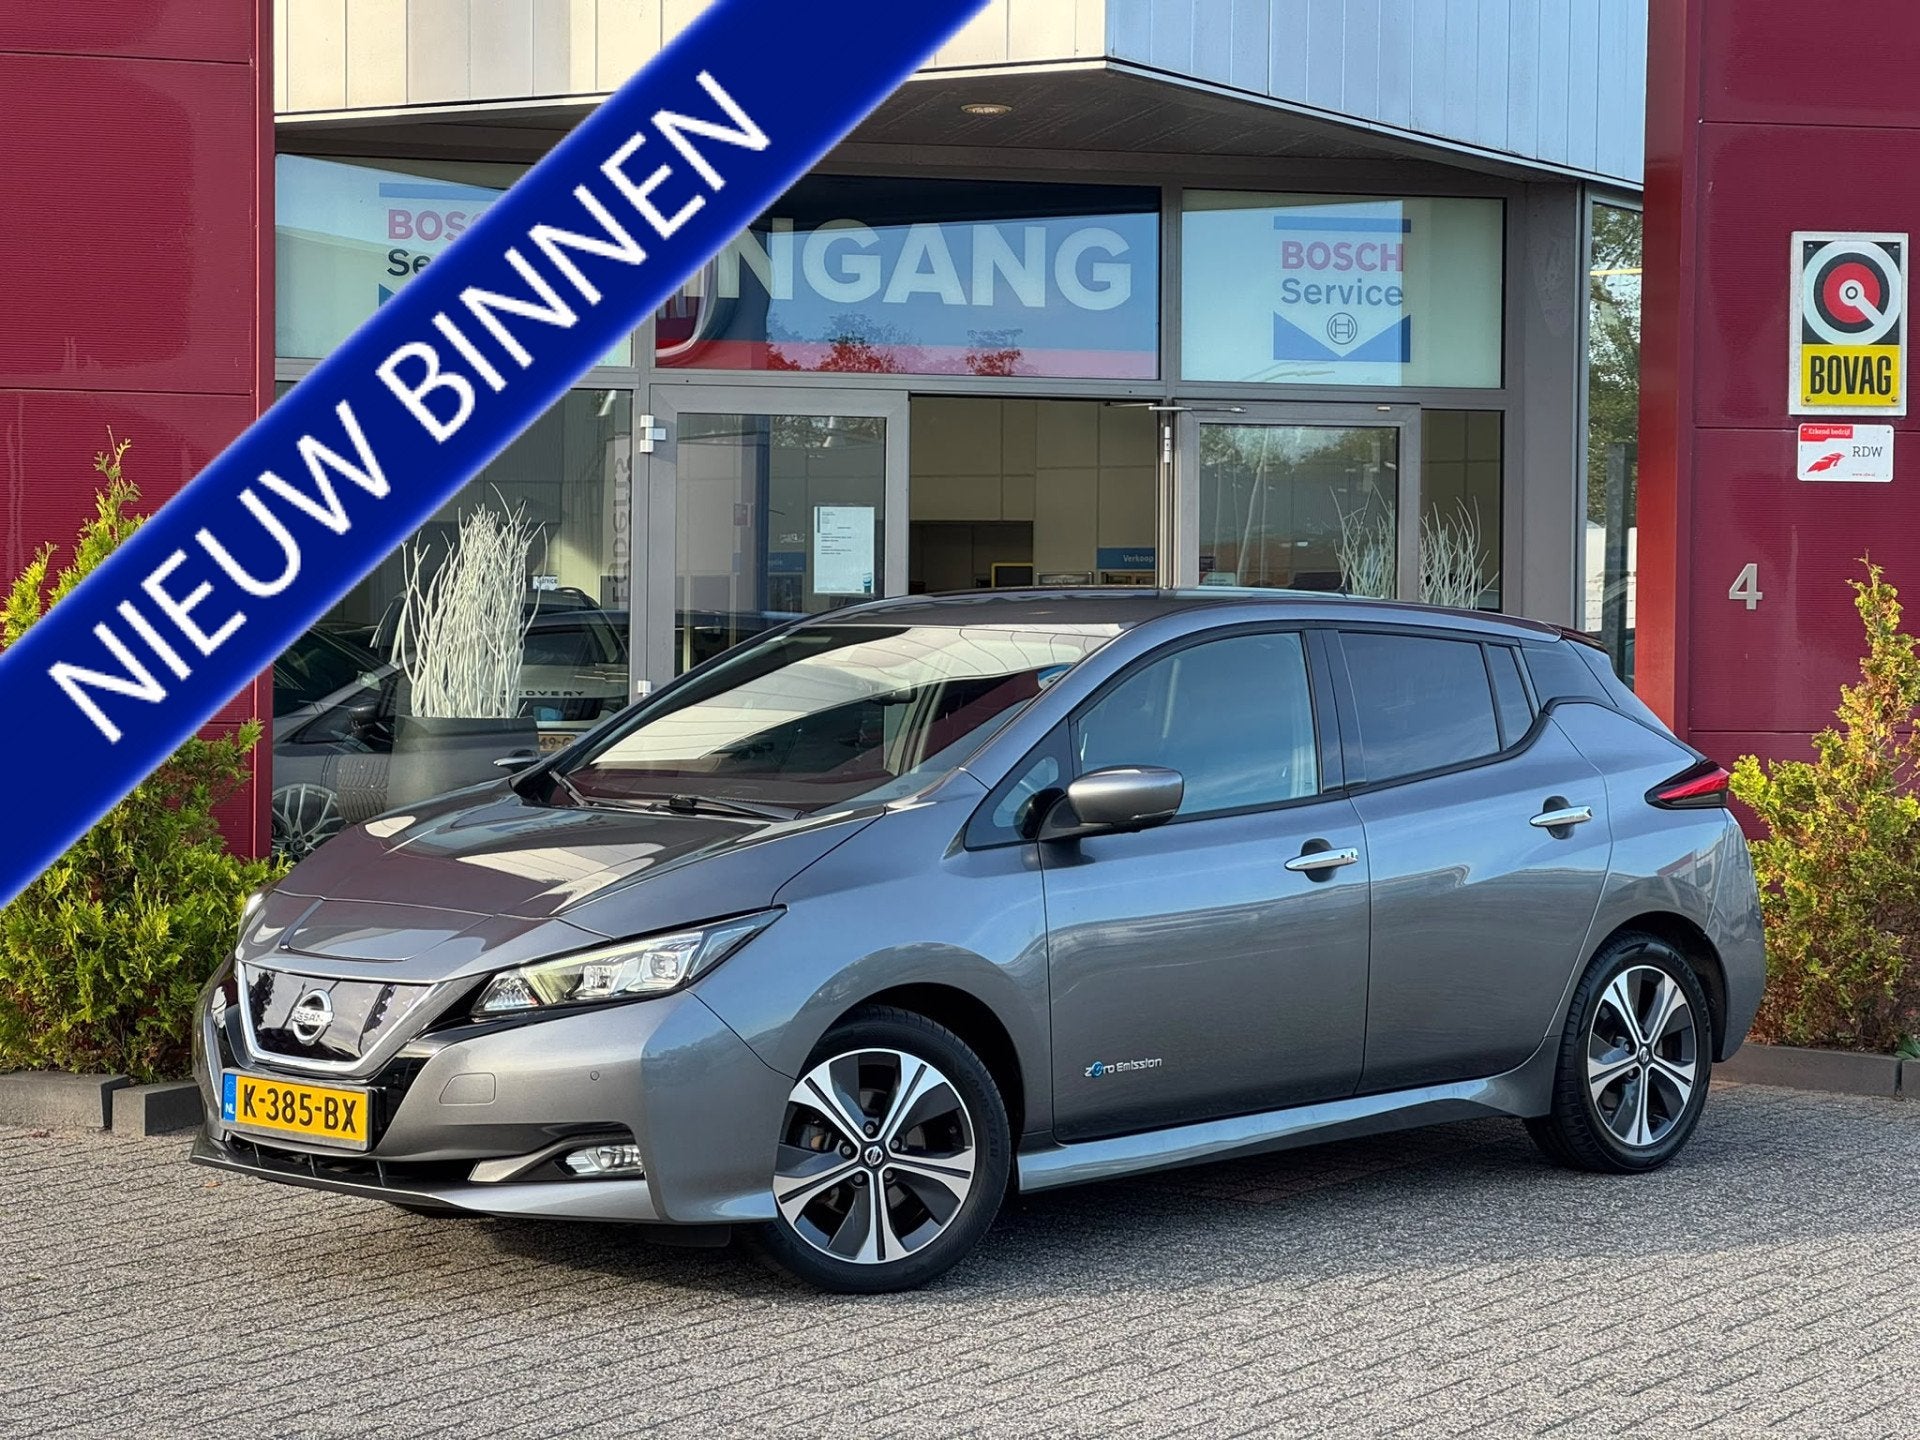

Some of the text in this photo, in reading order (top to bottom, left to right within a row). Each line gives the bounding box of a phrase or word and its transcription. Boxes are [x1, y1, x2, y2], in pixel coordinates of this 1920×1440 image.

[388, 208, 483, 241] BOS
[1281, 240, 1404, 272] BOSCH
[1280, 277, 1404, 307] Service
[1809, 355, 1892, 396] BOVAG
[1852, 446, 1883, 458] RDW
[1728, 563, 1763, 610] 4
[1116, 1058, 1162, 1072] Emission
[225, 1103, 234, 1114] NL
[243, 1083, 357, 1134] K-385-BX
